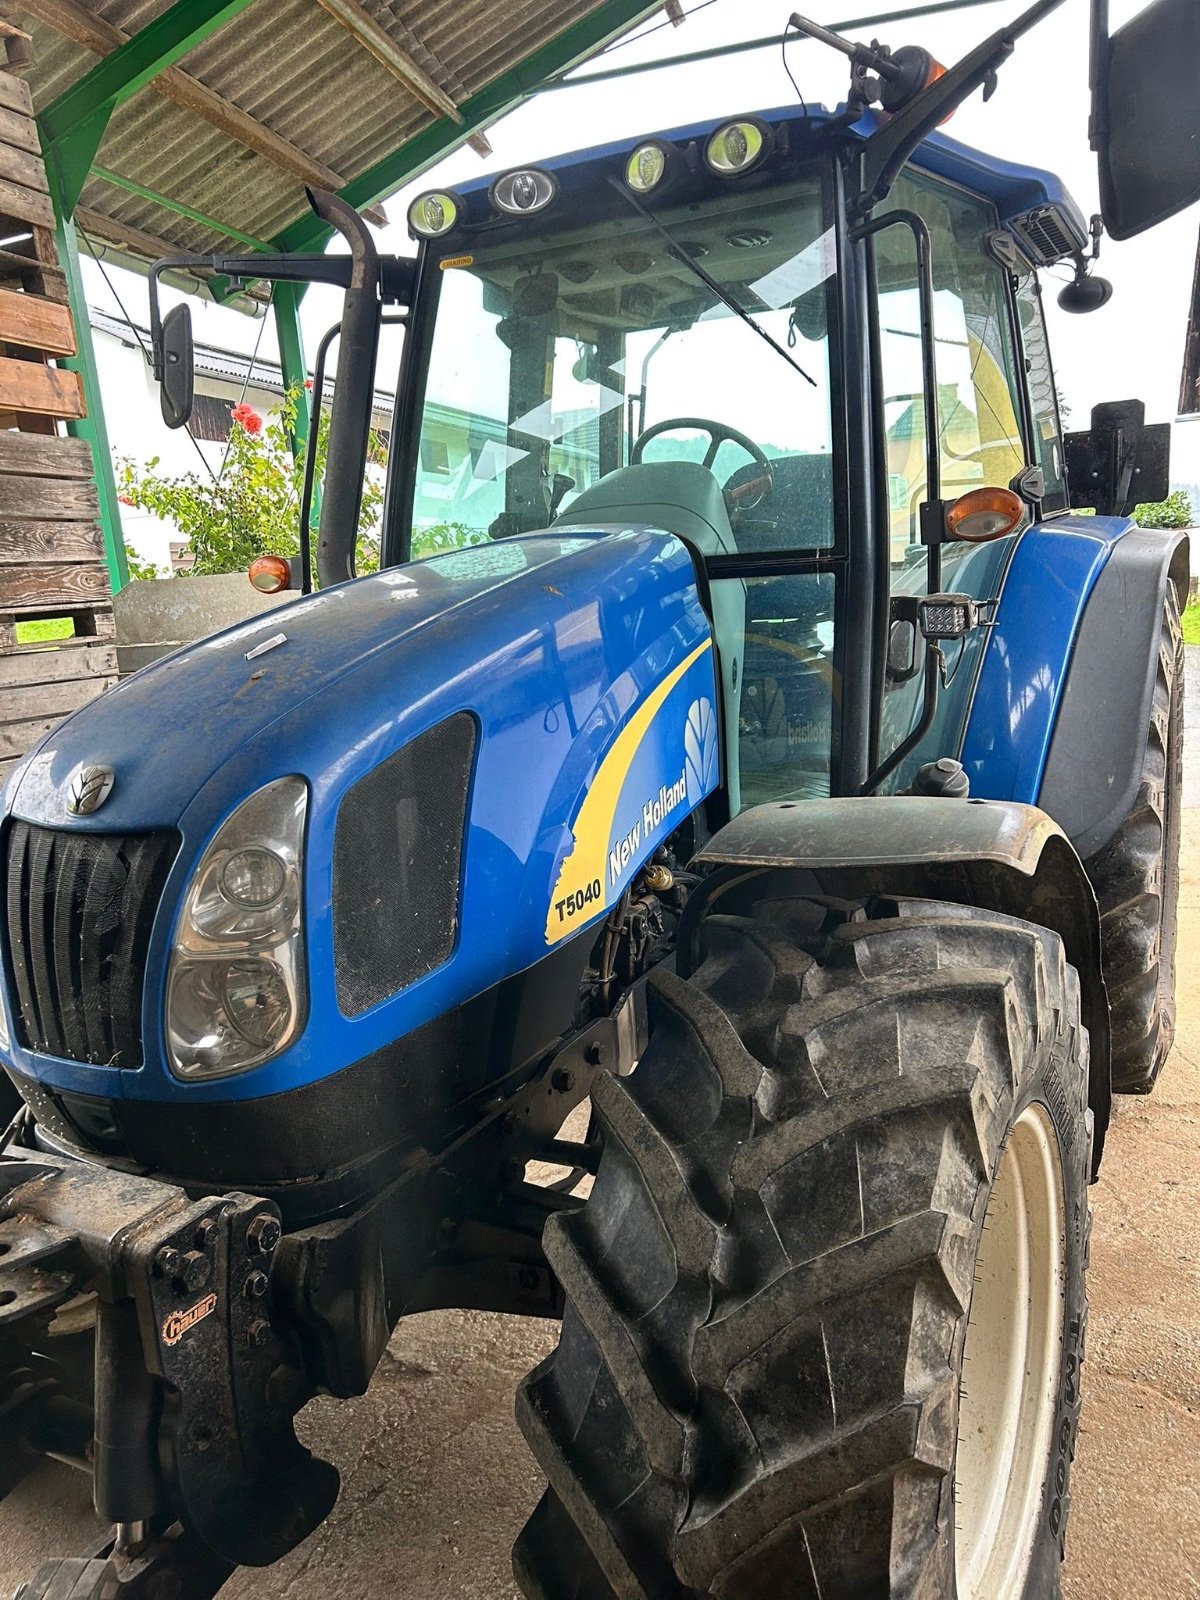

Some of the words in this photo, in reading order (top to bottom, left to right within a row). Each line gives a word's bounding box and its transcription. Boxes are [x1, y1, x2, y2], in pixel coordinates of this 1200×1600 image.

[609, 821, 641, 887] New
[643, 768, 686, 838] Holland
[555, 879, 600, 922] T5040
